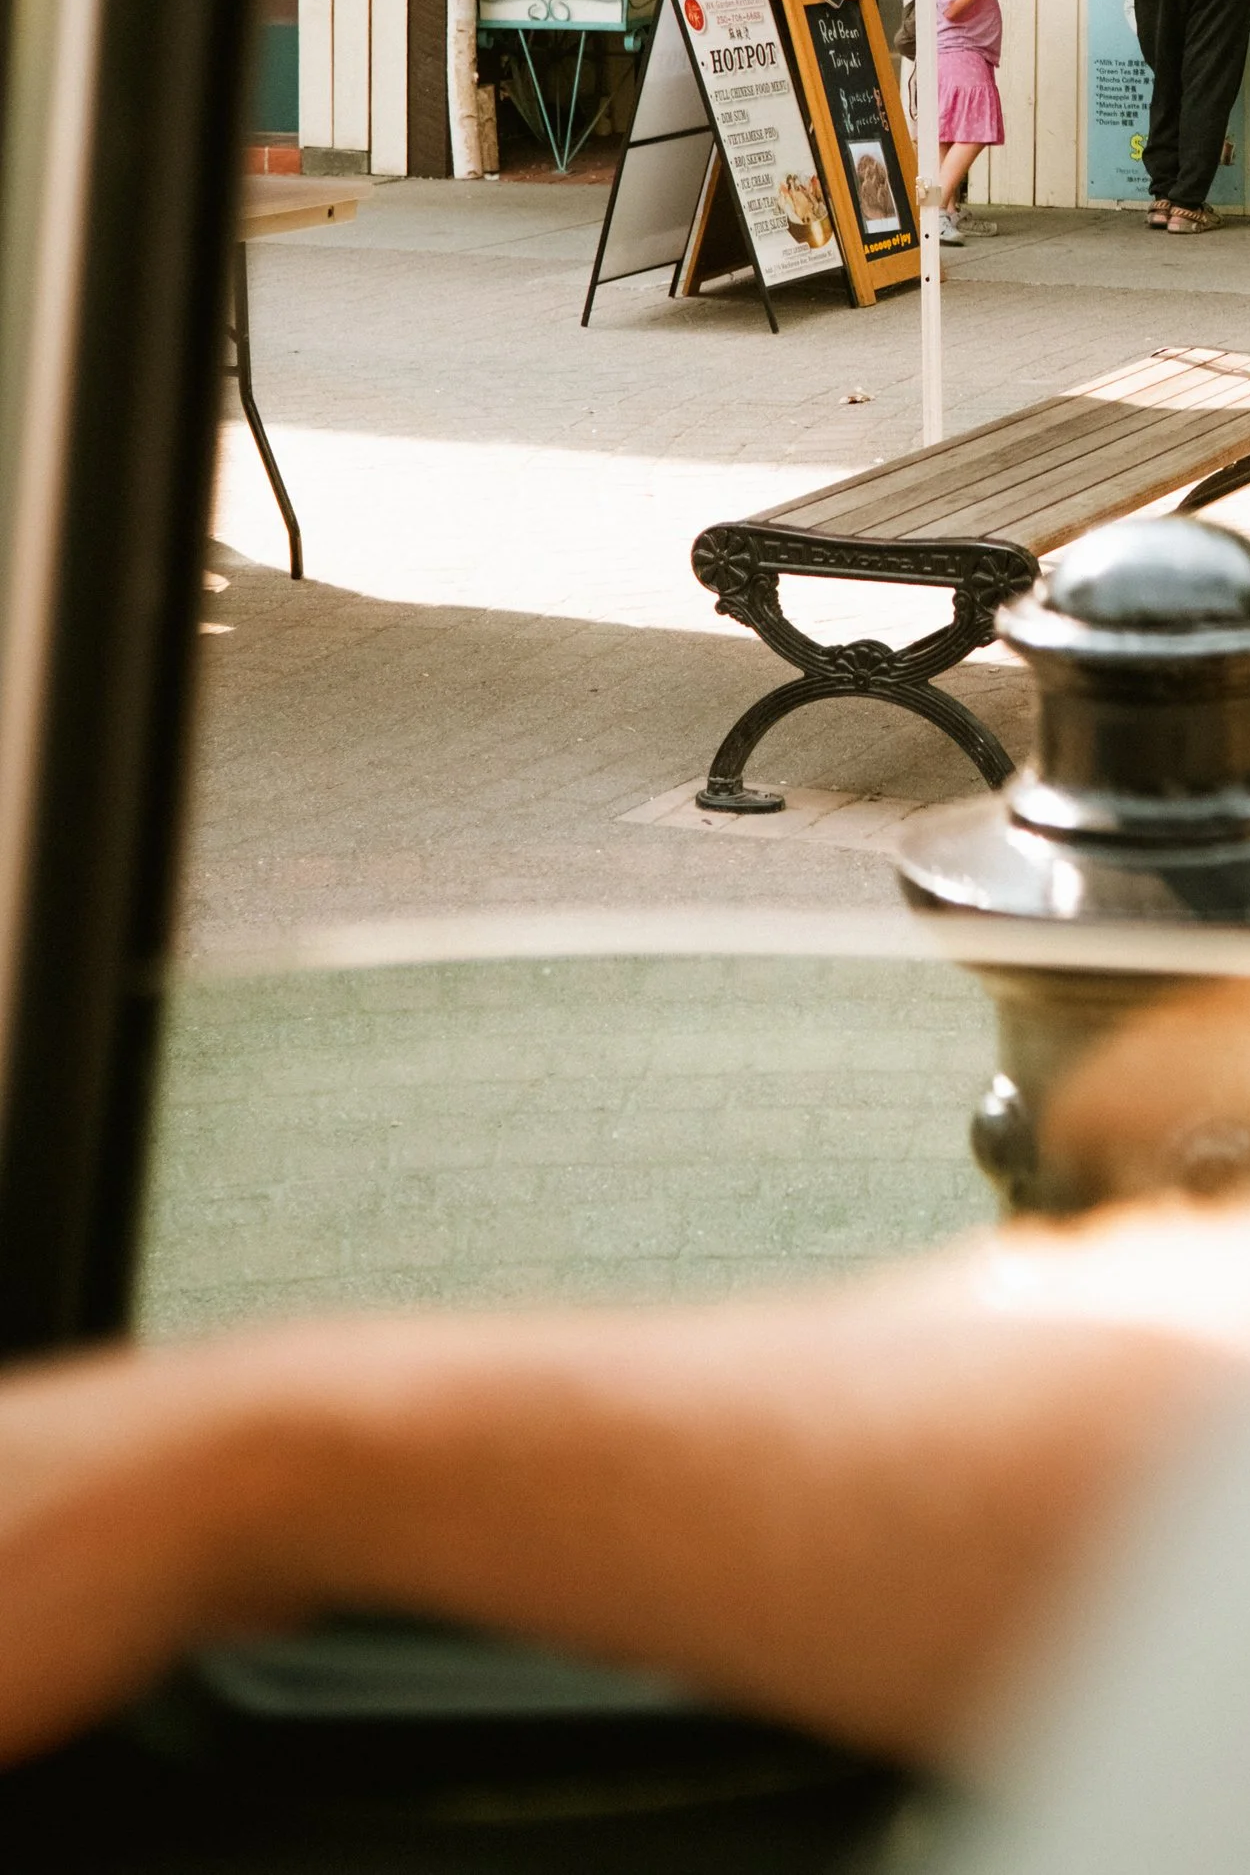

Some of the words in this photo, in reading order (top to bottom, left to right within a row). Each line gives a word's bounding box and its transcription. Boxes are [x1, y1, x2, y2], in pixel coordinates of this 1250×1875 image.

[818, 19, 839, 43] Red
[837, 19, 860, 39] Bean
[710, 41, 776, 74] HOTPOT
[829, 49, 861, 75] Taiyaki
[714, 88, 730, 102] FULL
[730, 85, 755, 99] CHINESE
[755, 82, 770, 95] FOOD
[1099, 93, 1130, 101] Pineapple
[721, 111, 733, 124] DIM
[733, 109, 747, 121] SUM
[764, 127, 778, 139] PHO
[734, 155, 746, 169] BBQ
[746, 150, 773, 165] SKEWERS
[740, 178, 751, 190] ICE
[751, 174, 772, 187] CREAM
[870, 238, 892, 253] scoop
[892, 234, 900, 246] of
[900, 232, 911, 247] joy
